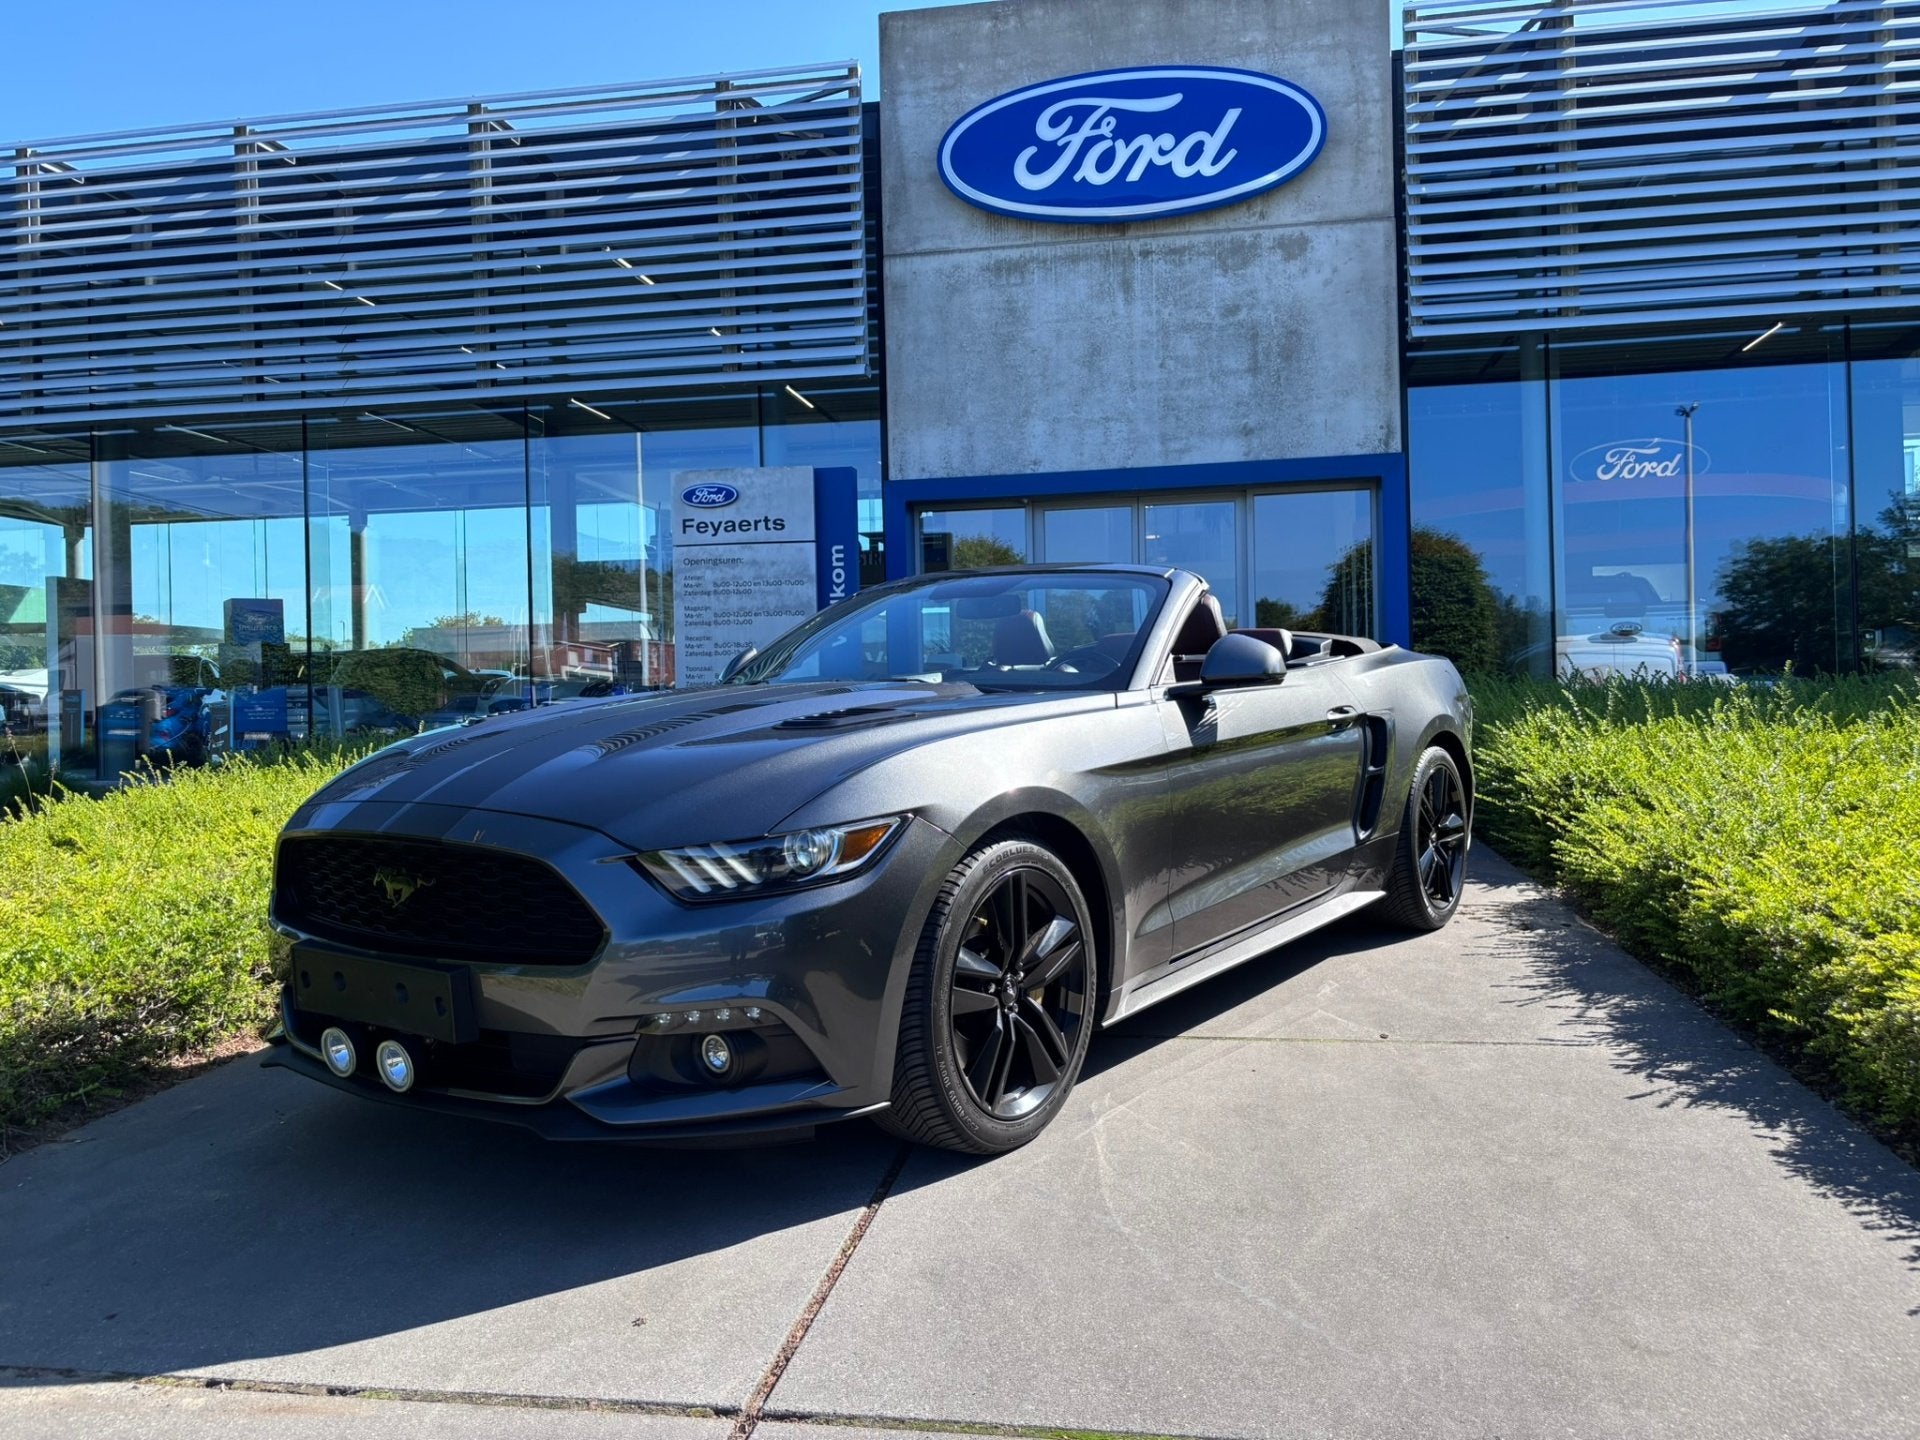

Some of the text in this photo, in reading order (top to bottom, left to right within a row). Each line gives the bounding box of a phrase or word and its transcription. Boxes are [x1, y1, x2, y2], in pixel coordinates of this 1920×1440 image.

[1013, 92, 1243, 191] Ford
[1596, 447, 1682, 481] Ford
[692, 487, 726, 503] Ford
[682, 515, 786, 537] Feyaerts
[682, 557, 744, 567] Openingsuren:
